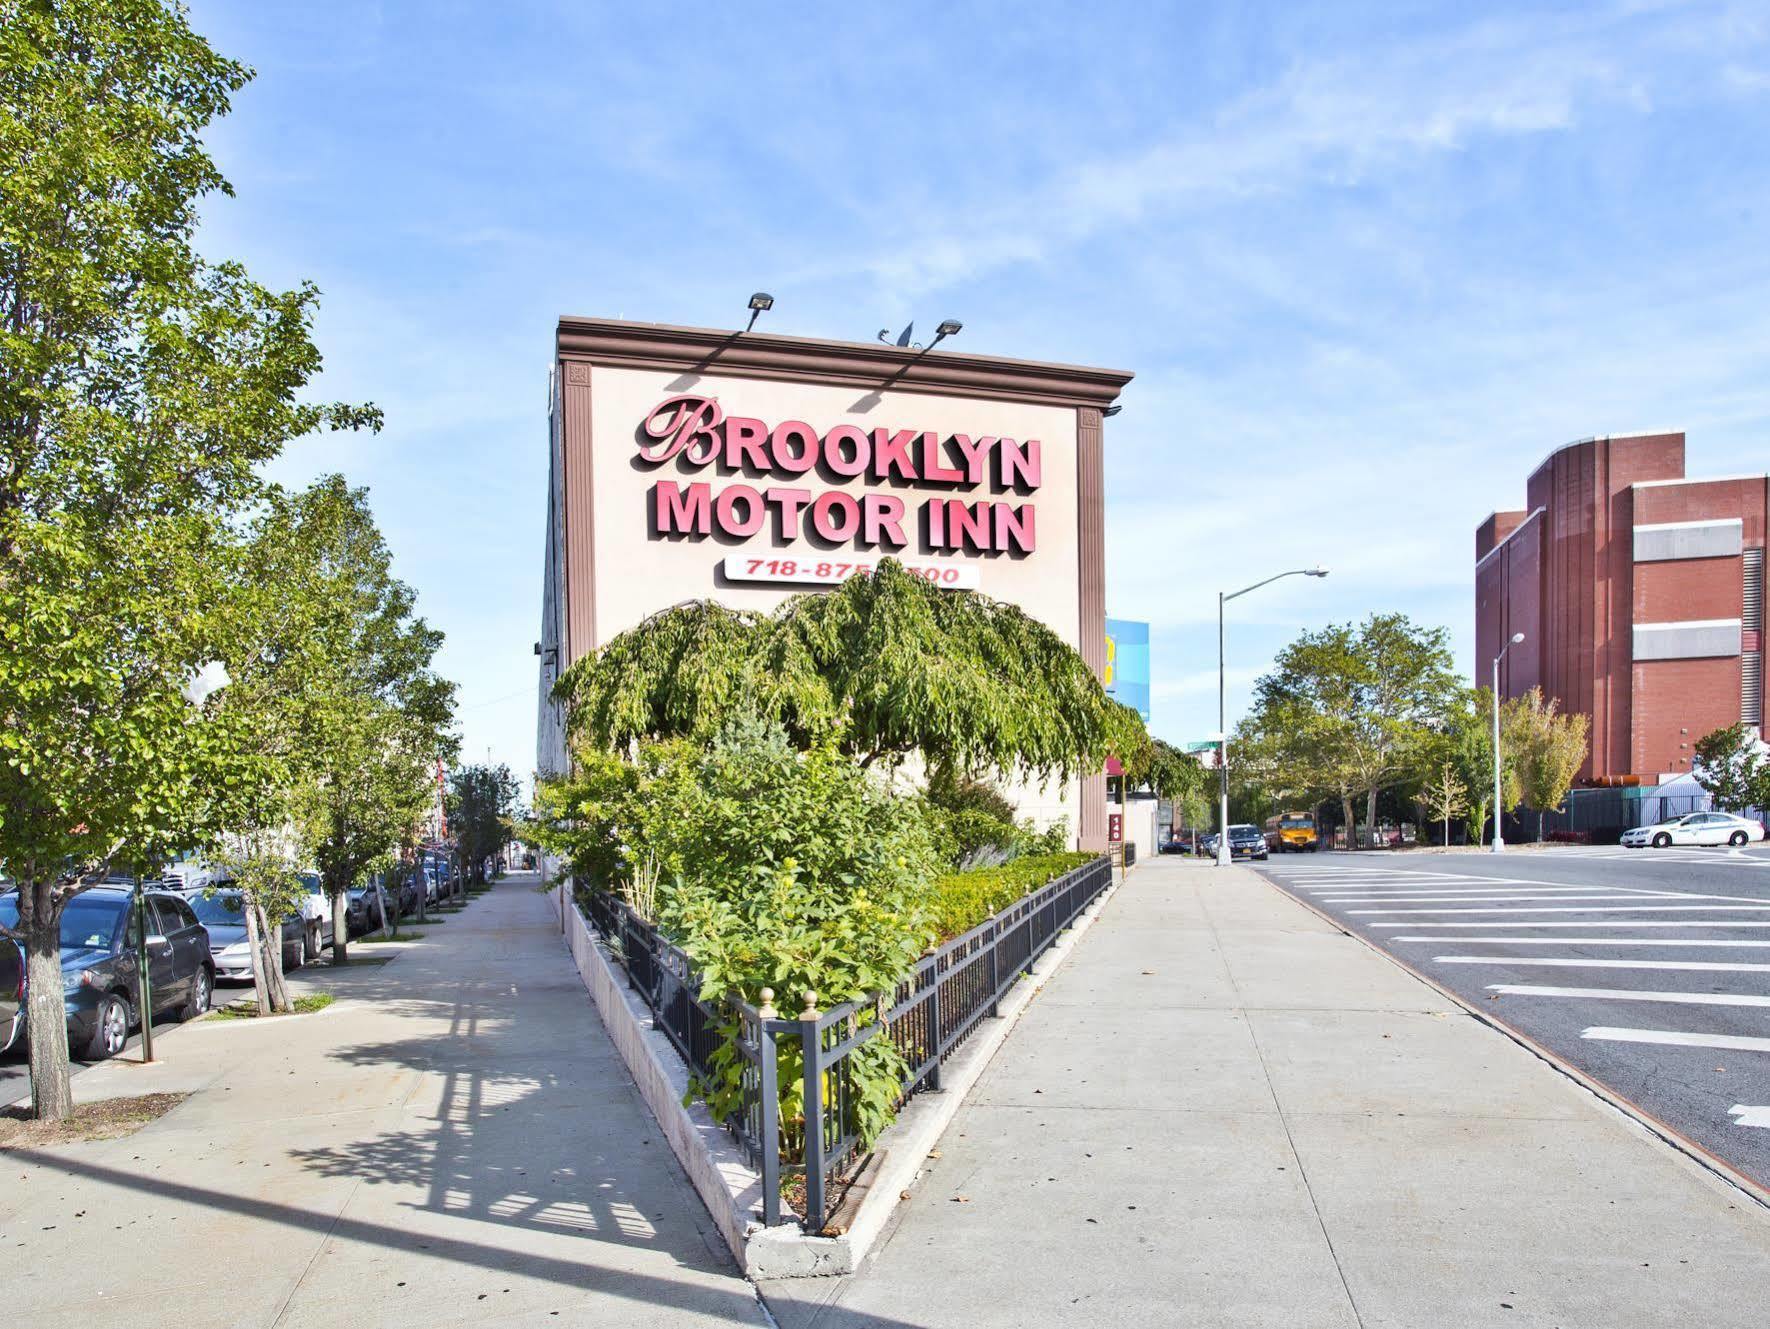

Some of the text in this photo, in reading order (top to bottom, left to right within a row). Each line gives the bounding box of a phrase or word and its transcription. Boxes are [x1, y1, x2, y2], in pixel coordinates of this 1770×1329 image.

[639, 394, 1042, 489] BROOKLYN
[656, 480, 1036, 553] MOTOR INN
